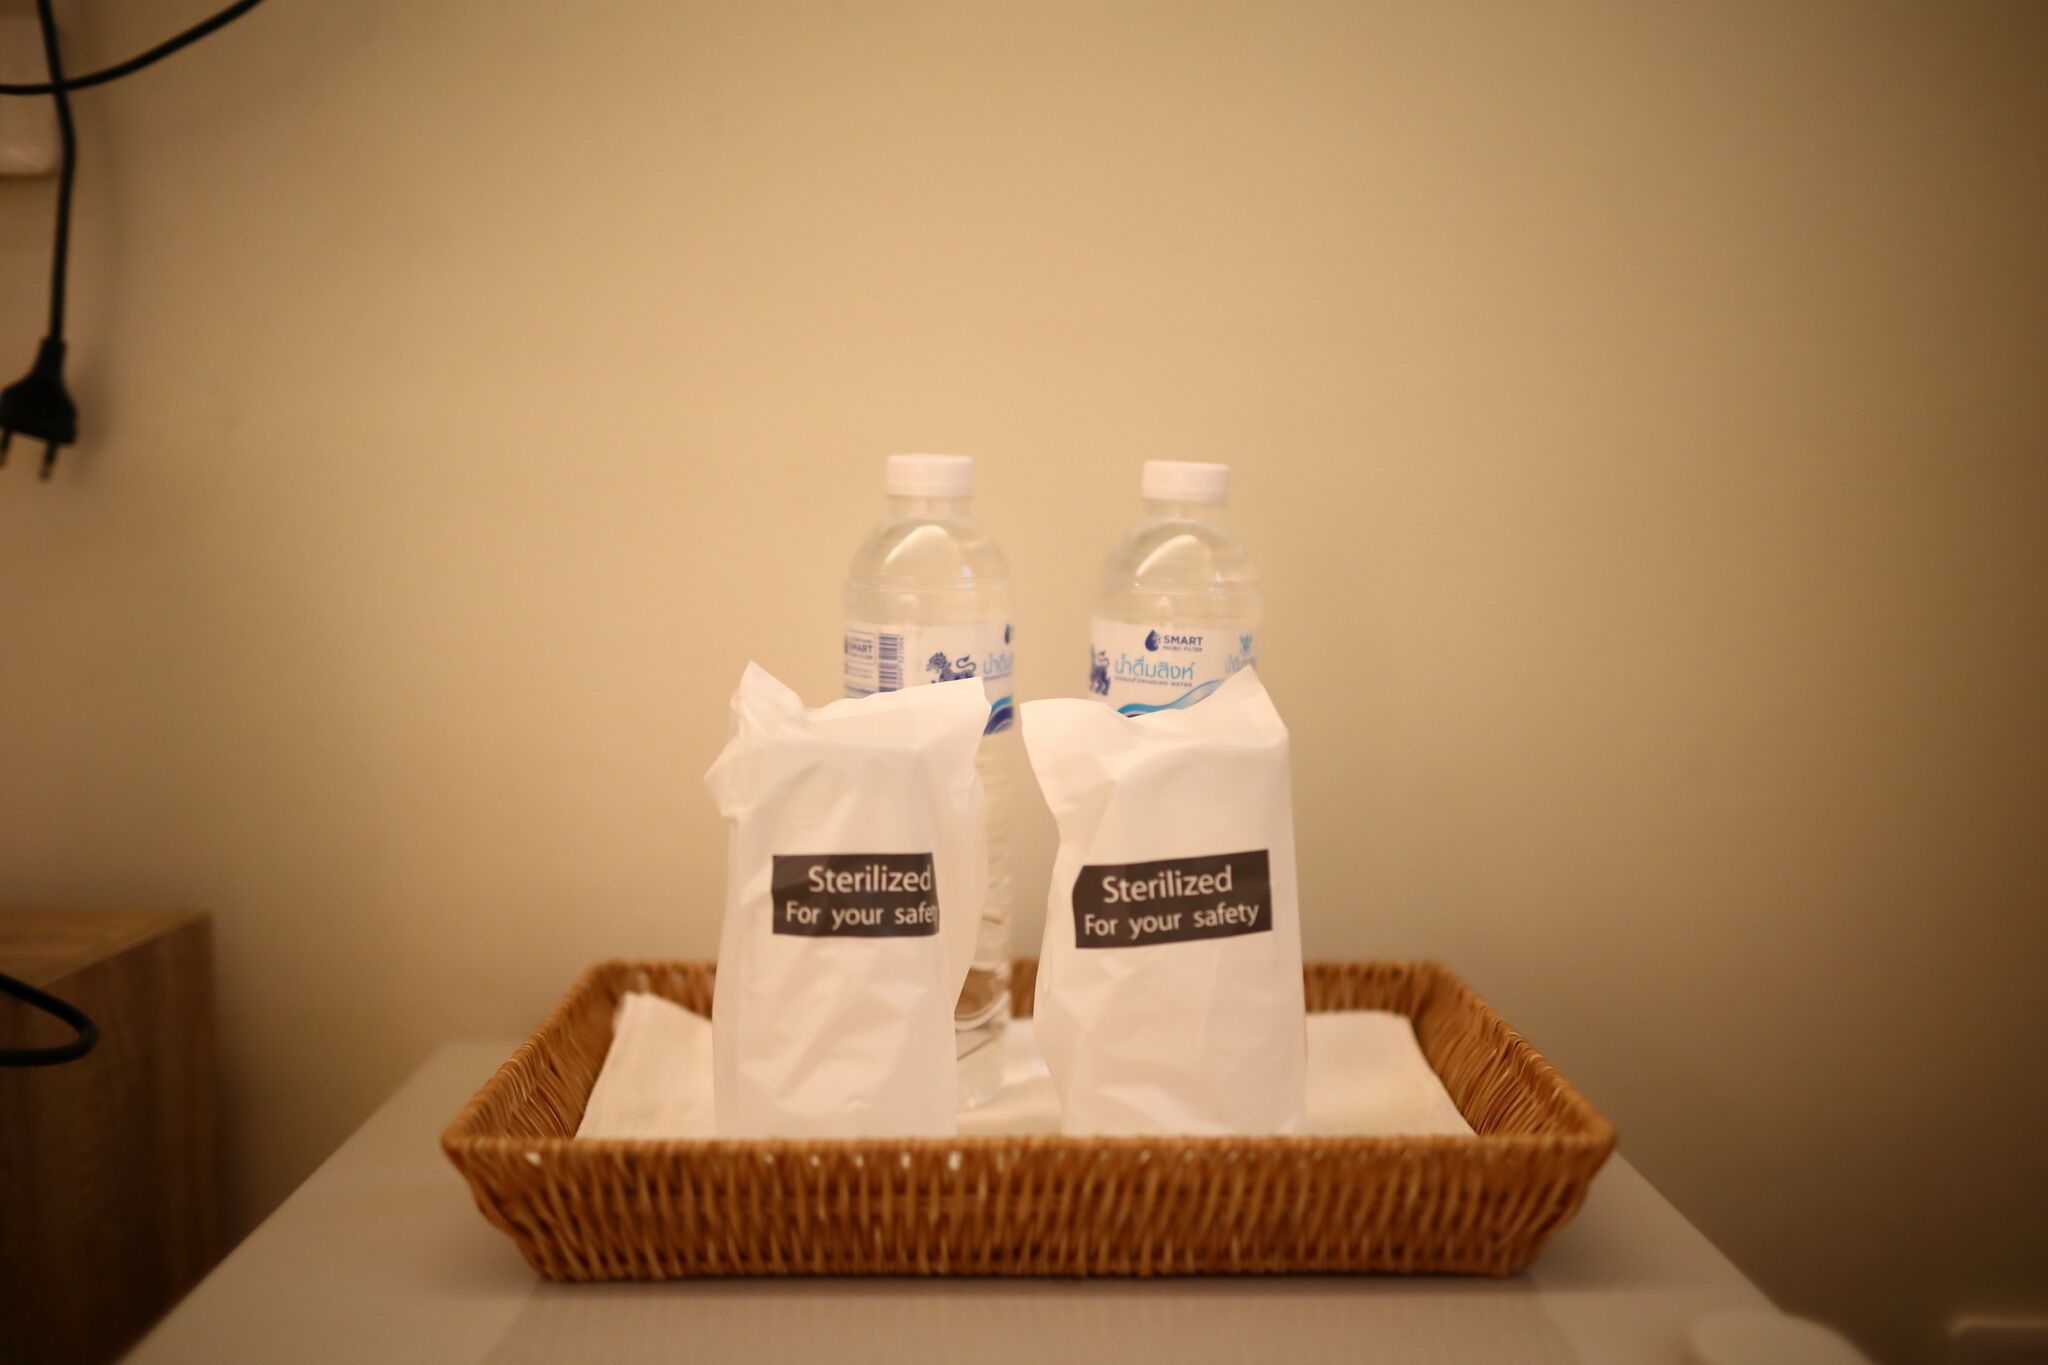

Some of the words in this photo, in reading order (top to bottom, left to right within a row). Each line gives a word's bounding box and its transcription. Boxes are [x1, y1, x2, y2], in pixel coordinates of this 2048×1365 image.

[1163, 634, 1204, 646] SMART
[808, 864, 932, 894] Sterilized
[1102, 864, 1233, 904] Sterilized
[786, 901, 821, 925] For
[831, 906, 885, 931] your
[894, 901, 939, 928] safe
[1084, 913, 1119, 936] For
[1127, 911, 1183, 940] your
[1192, 901, 1260, 928] safety
